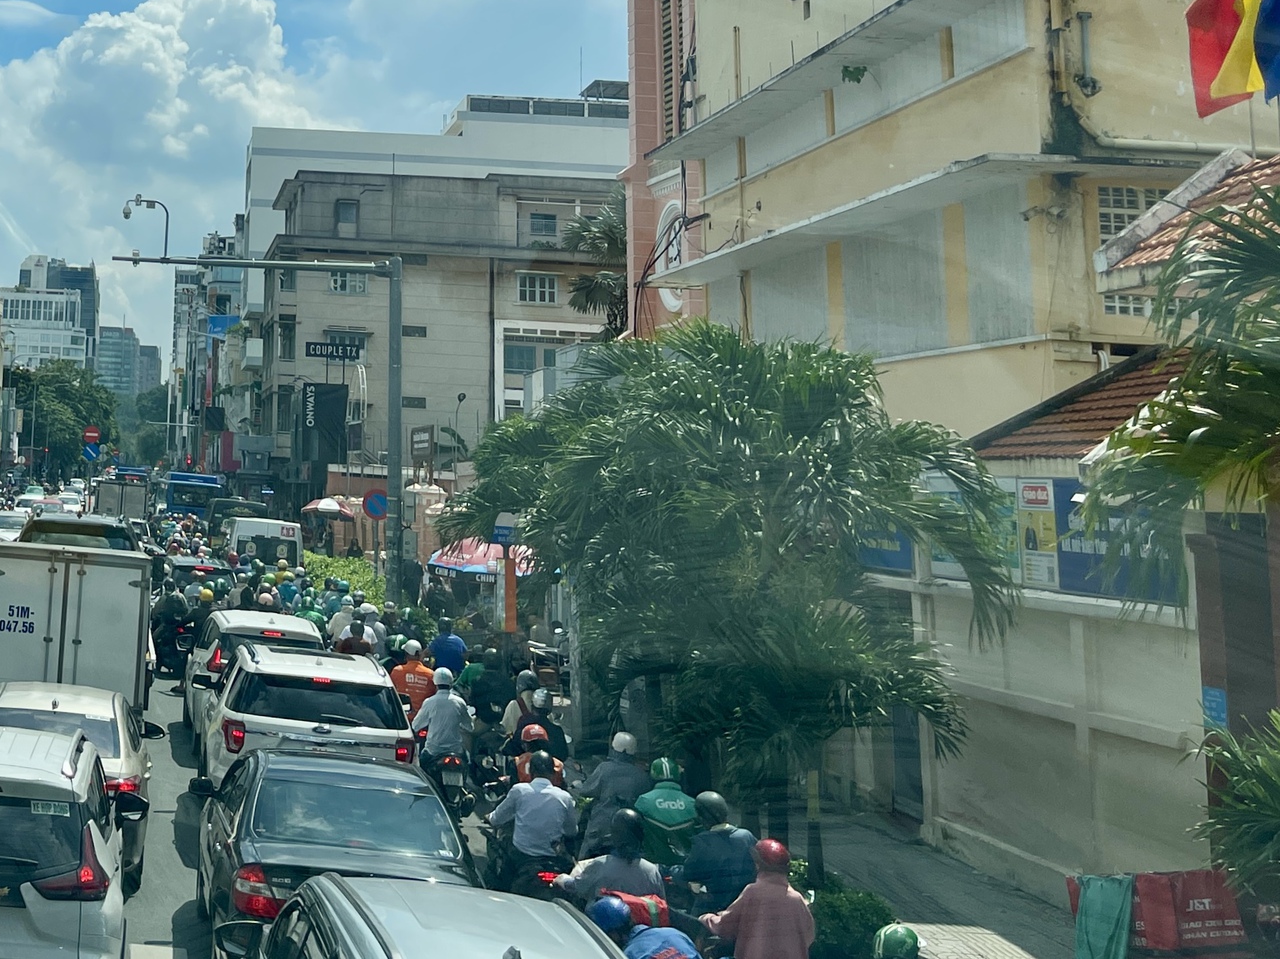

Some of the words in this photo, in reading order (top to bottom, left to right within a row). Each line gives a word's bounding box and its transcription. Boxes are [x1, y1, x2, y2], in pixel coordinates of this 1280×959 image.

[309, 344, 344, 356] COUPLE
[345, 346, 357, 357] TX
[305, 385, 316, 427] ONWAYS
[8, 604, 35, 619] 51M-
[0, 620, 35, 634] 047.56
[655, 798, 686, 811] Grab
[1185, 898, 1212, 912] J&T
